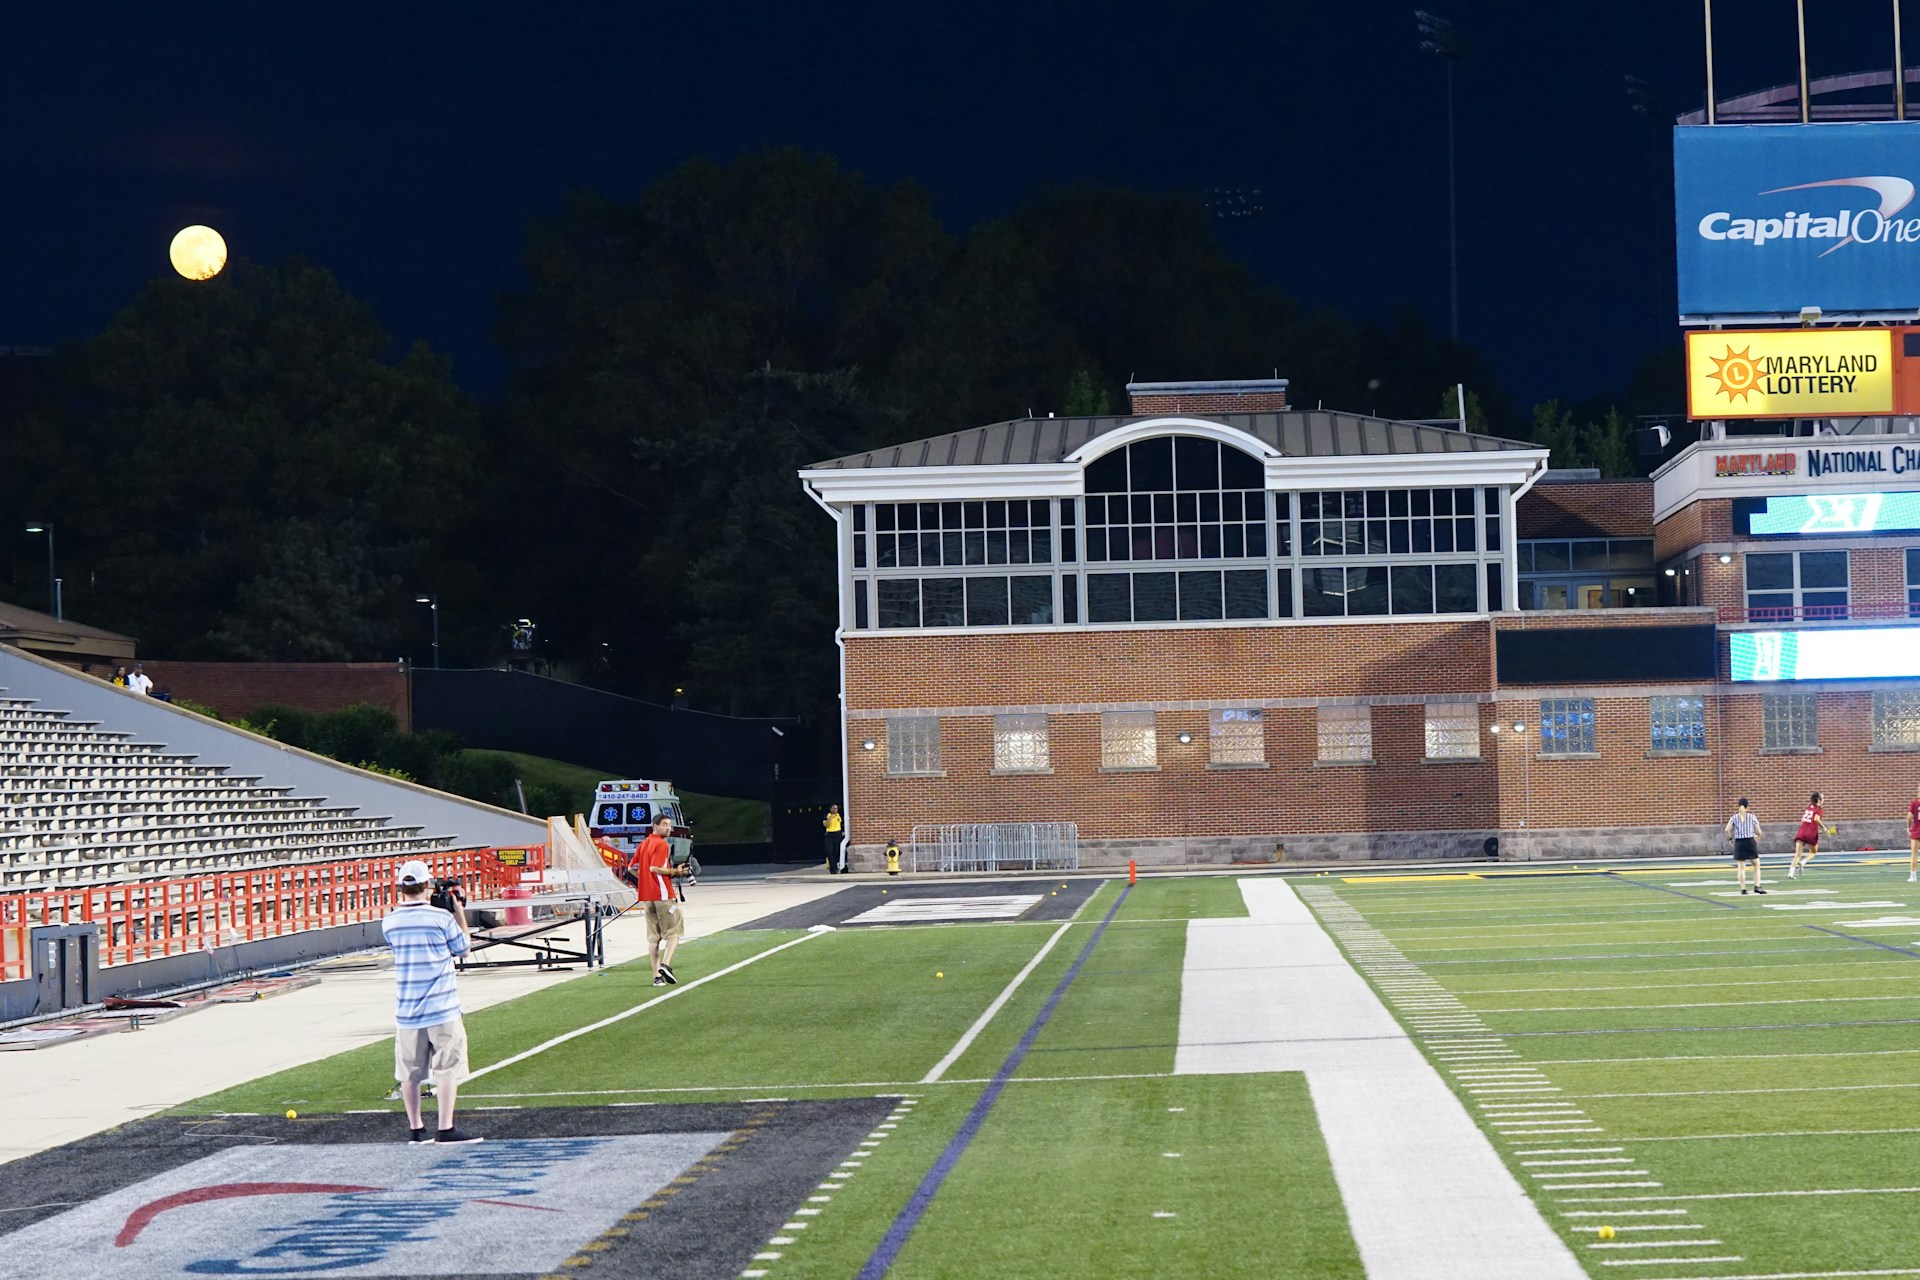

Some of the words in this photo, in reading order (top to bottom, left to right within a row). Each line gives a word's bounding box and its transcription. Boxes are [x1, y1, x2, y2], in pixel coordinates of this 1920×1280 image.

[1766, 354, 1877, 375] MARYLAND
[1766, 375, 1857, 395] LOTTERY
[1715, 453, 1797, 473] MARYLAND
[1808, 449, 1887, 477] NATIONAL
[1803, 809, 1814, 823] 22
